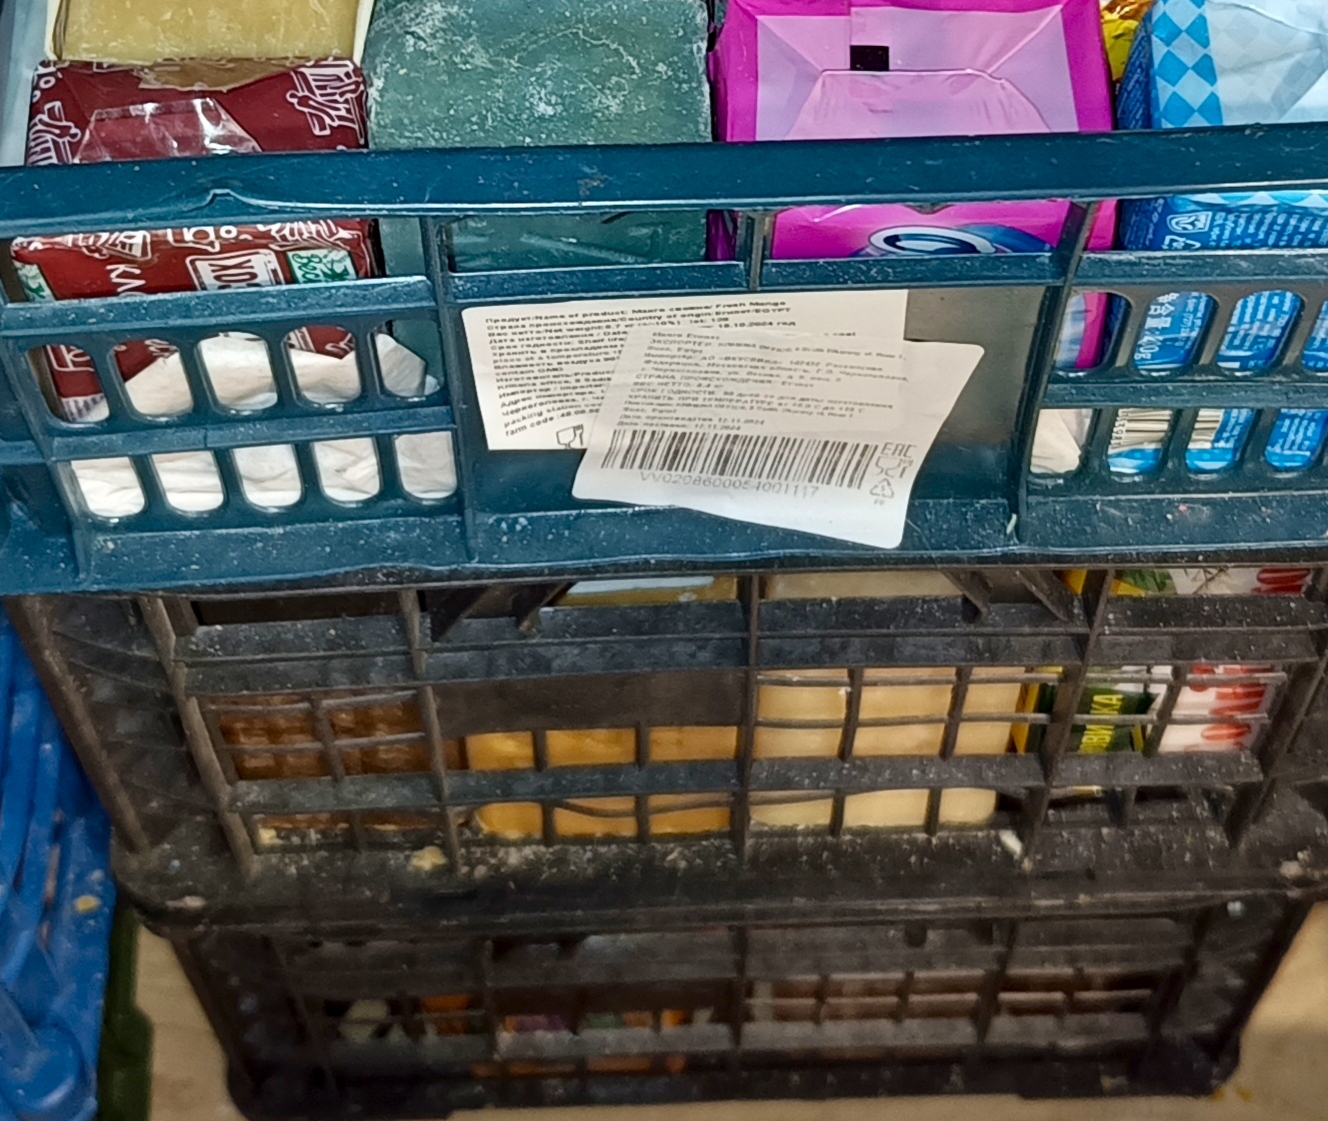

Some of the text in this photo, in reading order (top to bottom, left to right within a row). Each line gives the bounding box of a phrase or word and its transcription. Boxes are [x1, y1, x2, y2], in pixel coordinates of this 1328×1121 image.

[715, 302, 746, 310] Fresh
[749, 300, 787, 309] Mango
[487, 323, 527, 331] Страна
[489, 337, 515, 345] Дата
[518, 332, 594, 342] изготовления
[490, 344, 518, 352] Срок
[492, 349, 538, 357] хранить
[550, 343, 619, 354] прохладном
[493, 356, 522, 365] place
[546, 350, 610, 361] temperature
[493, 357, 601, 370] Влажность воздуха
[495, 369, 535, 377] contain
[635, 373, 676, 381] СТРАНА
[499, 387, 551, 399] Импортер
[500, 395, 533, 408] Адрес
[504, 404, 582, 429] packing station
[505, 415, 555, 437] farm code
